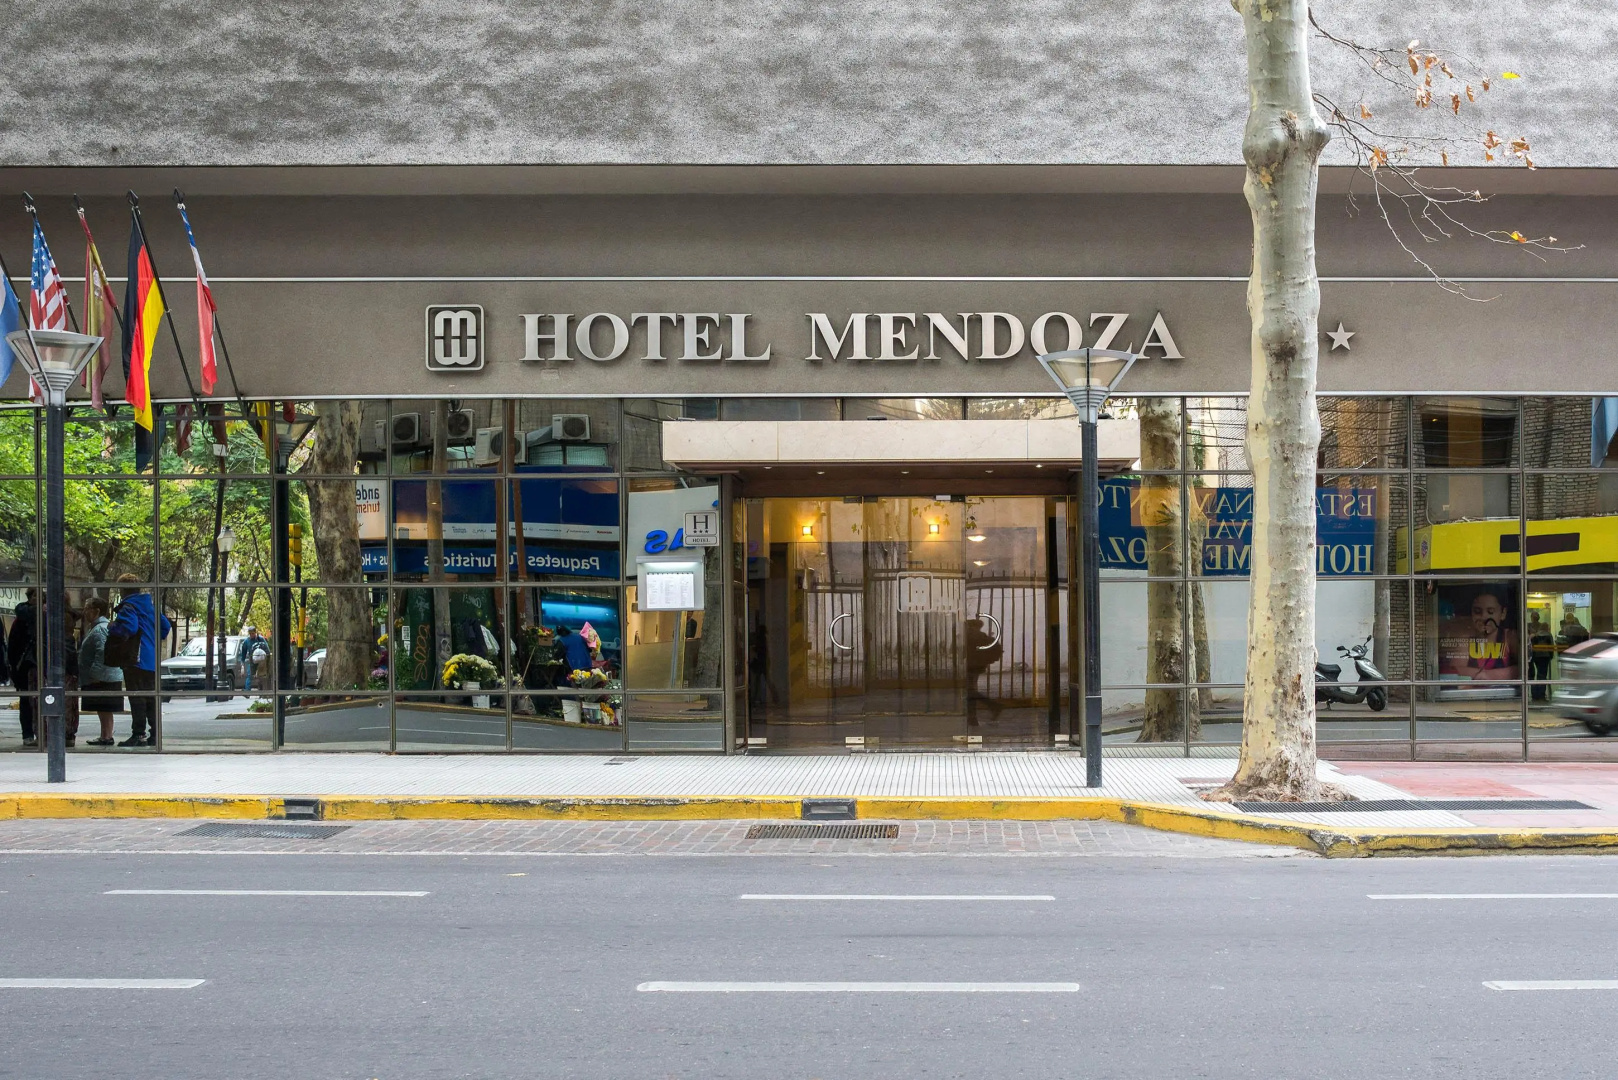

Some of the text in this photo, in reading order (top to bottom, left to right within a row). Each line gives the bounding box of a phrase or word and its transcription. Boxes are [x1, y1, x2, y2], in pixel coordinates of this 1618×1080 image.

[519, 311, 1185, 362] HOTEL MENDOZA
[693, 515, 709, 529] H
